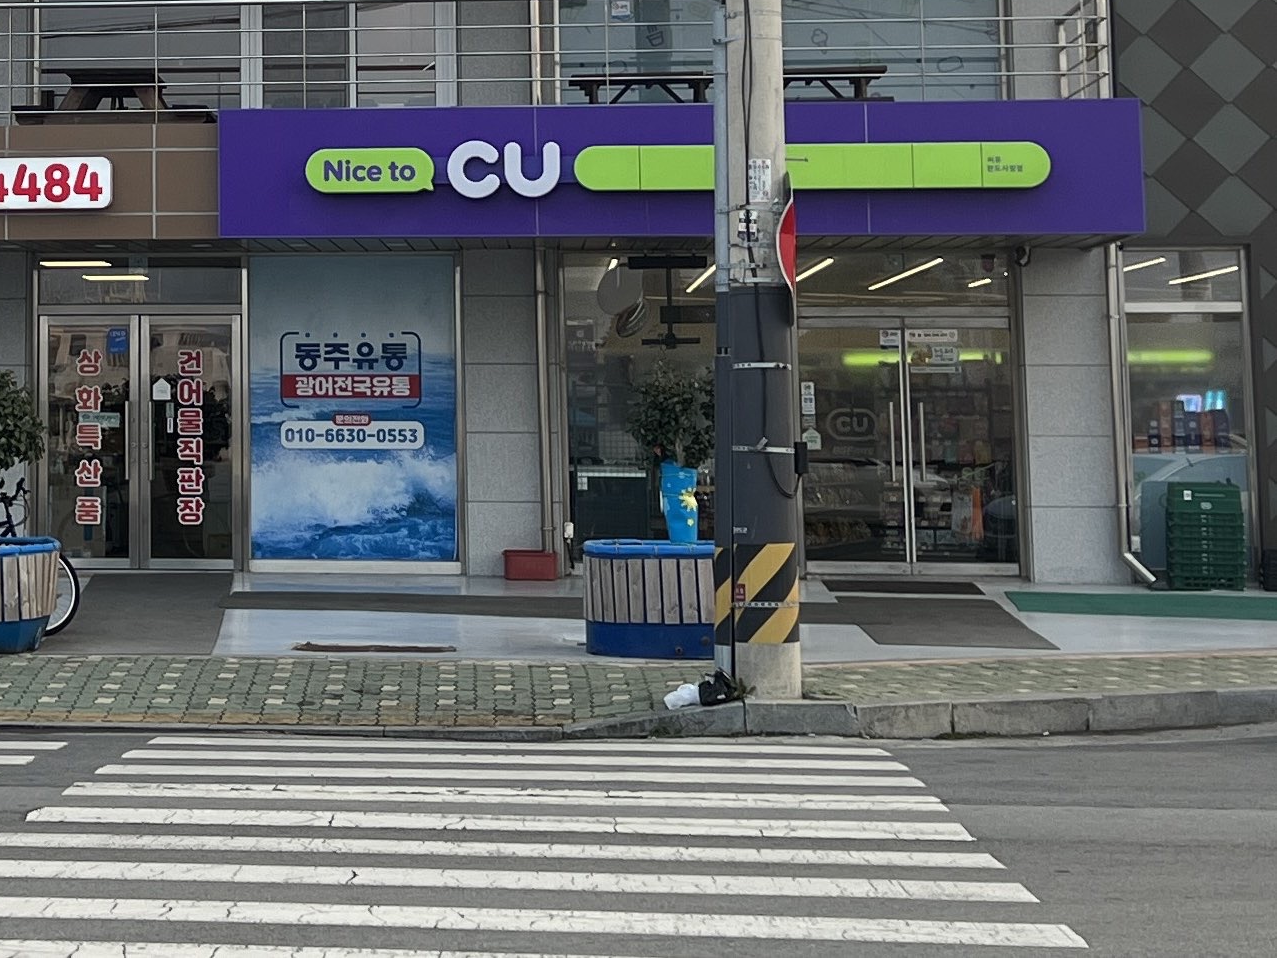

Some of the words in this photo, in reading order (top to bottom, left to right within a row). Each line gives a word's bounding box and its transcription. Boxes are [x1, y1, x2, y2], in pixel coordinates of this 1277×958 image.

[323, 159, 382, 182] Nice
[388, 160, 416, 182] to
[447, 140, 561, 199] CU
[295, 342, 407, 371] 동주유통
[295, 377, 410, 396] 광어전국유통
[75, 349, 102, 525] 상화특산품
[177, 349, 204, 525] 건어물직판장
[284, 428, 418, 443] 010-6630-0553
